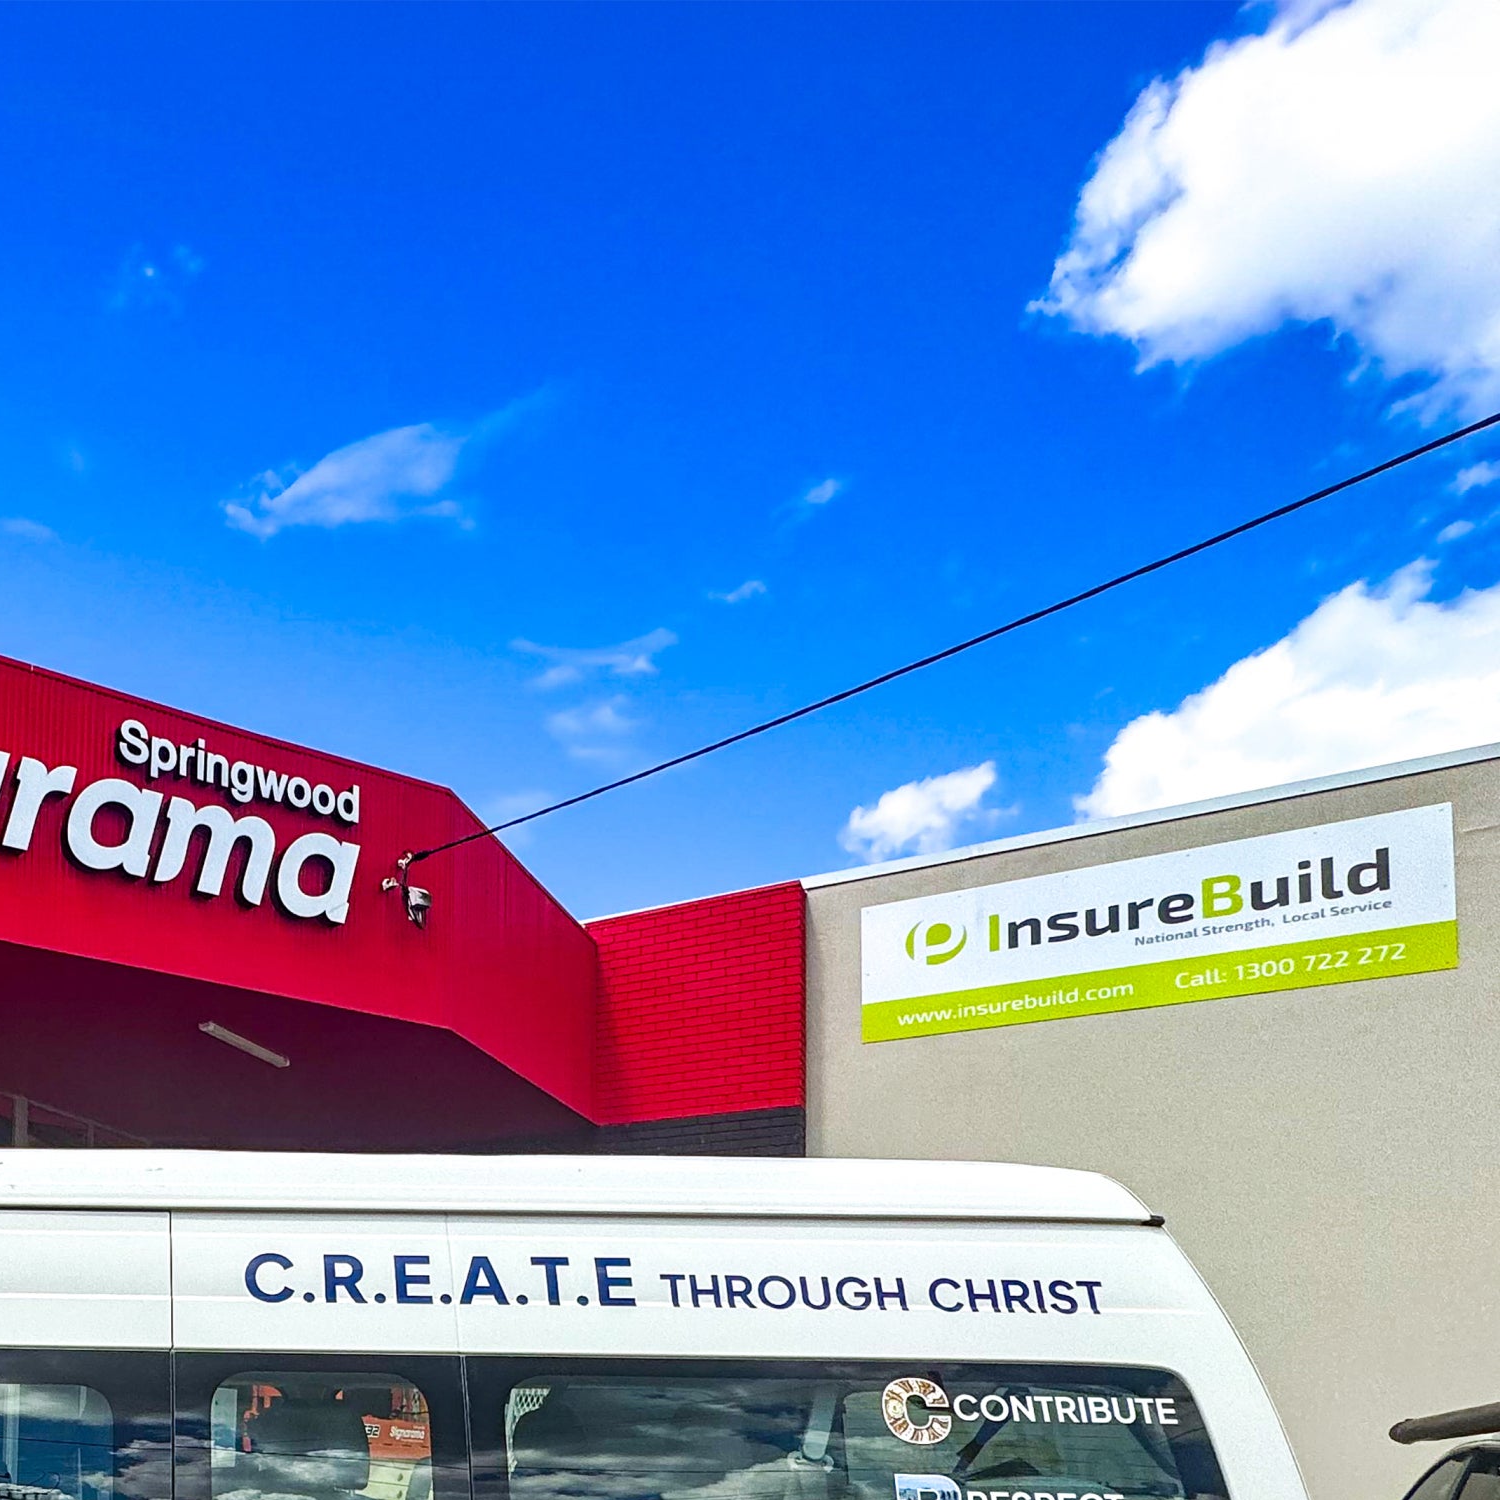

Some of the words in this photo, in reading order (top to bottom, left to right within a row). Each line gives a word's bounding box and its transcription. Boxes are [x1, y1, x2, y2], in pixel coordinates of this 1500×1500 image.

[119, 719, 360, 823] Springwood
[989, 847, 1391, 951] InsureBuild
[1134, 928, 1198, 946] National
[1202, 917, 1275, 937] Strength,
[1282, 909, 1326, 924] Local
[1330, 899, 1392, 916] Service
[1175, 970, 1226, 989] Call:
[1235, 957, 1295, 979] 1300
[1304, 950, 1349, 971] 722
[1357, 943, 1406, 963] 272
[897, 980, 1135, 1025] www.insurebuild.com
[244, 1252, 638, 1308] C.R.E.A.T.E
[660, 1274, 909, 1312] THROUGH
[927, 1277, 1102, 1316] CHRIST
[881, 1377, 952, 1445] C
[953, 1394, 1179, 1425] CONTRIBUTE
